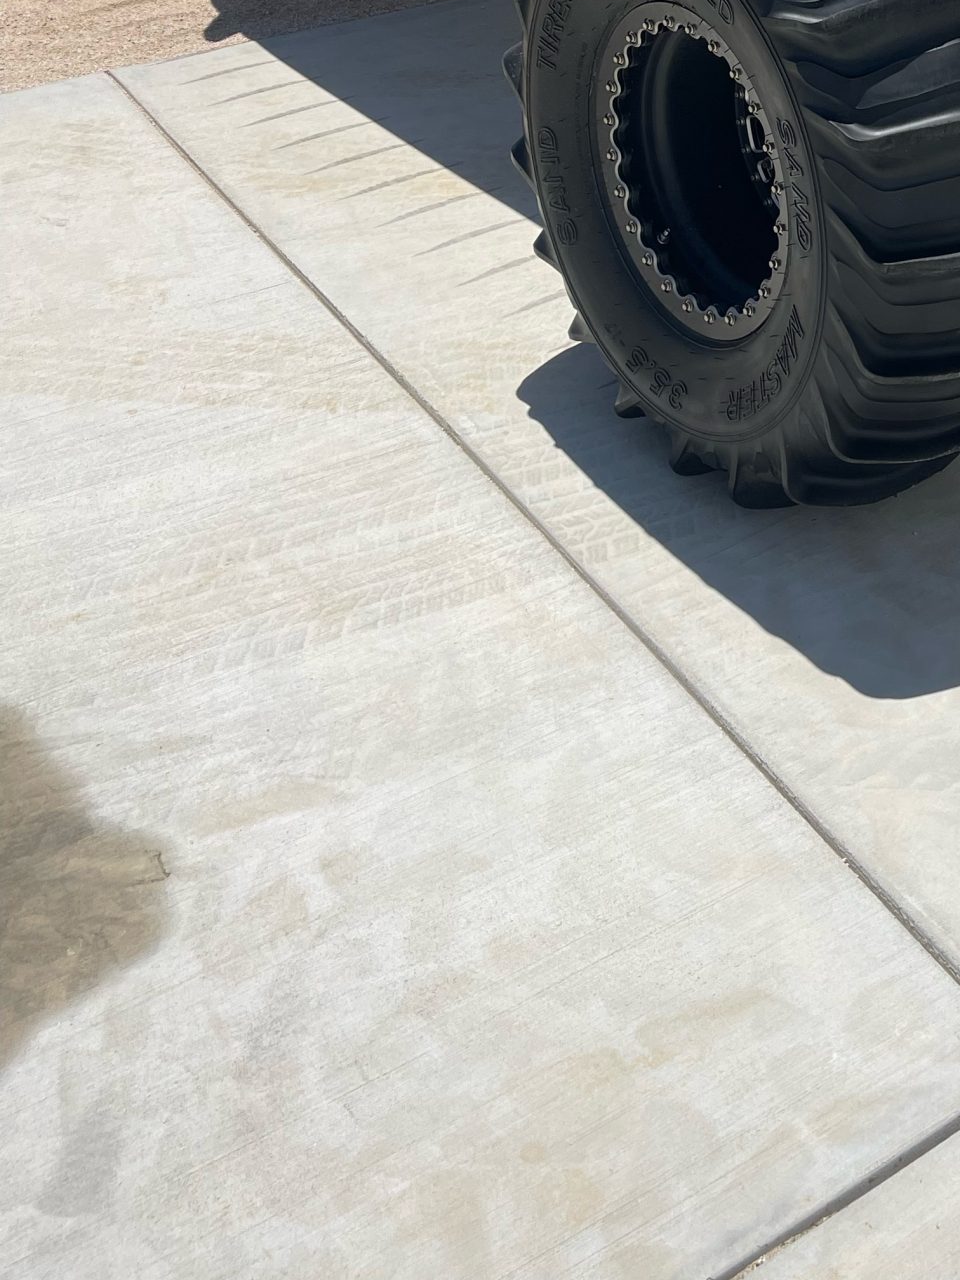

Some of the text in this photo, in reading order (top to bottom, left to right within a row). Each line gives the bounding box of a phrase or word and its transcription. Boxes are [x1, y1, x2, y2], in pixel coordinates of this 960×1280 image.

[538, 125, 579, 247] SAND
[726, 116, 814, 422] SAND MASTER
